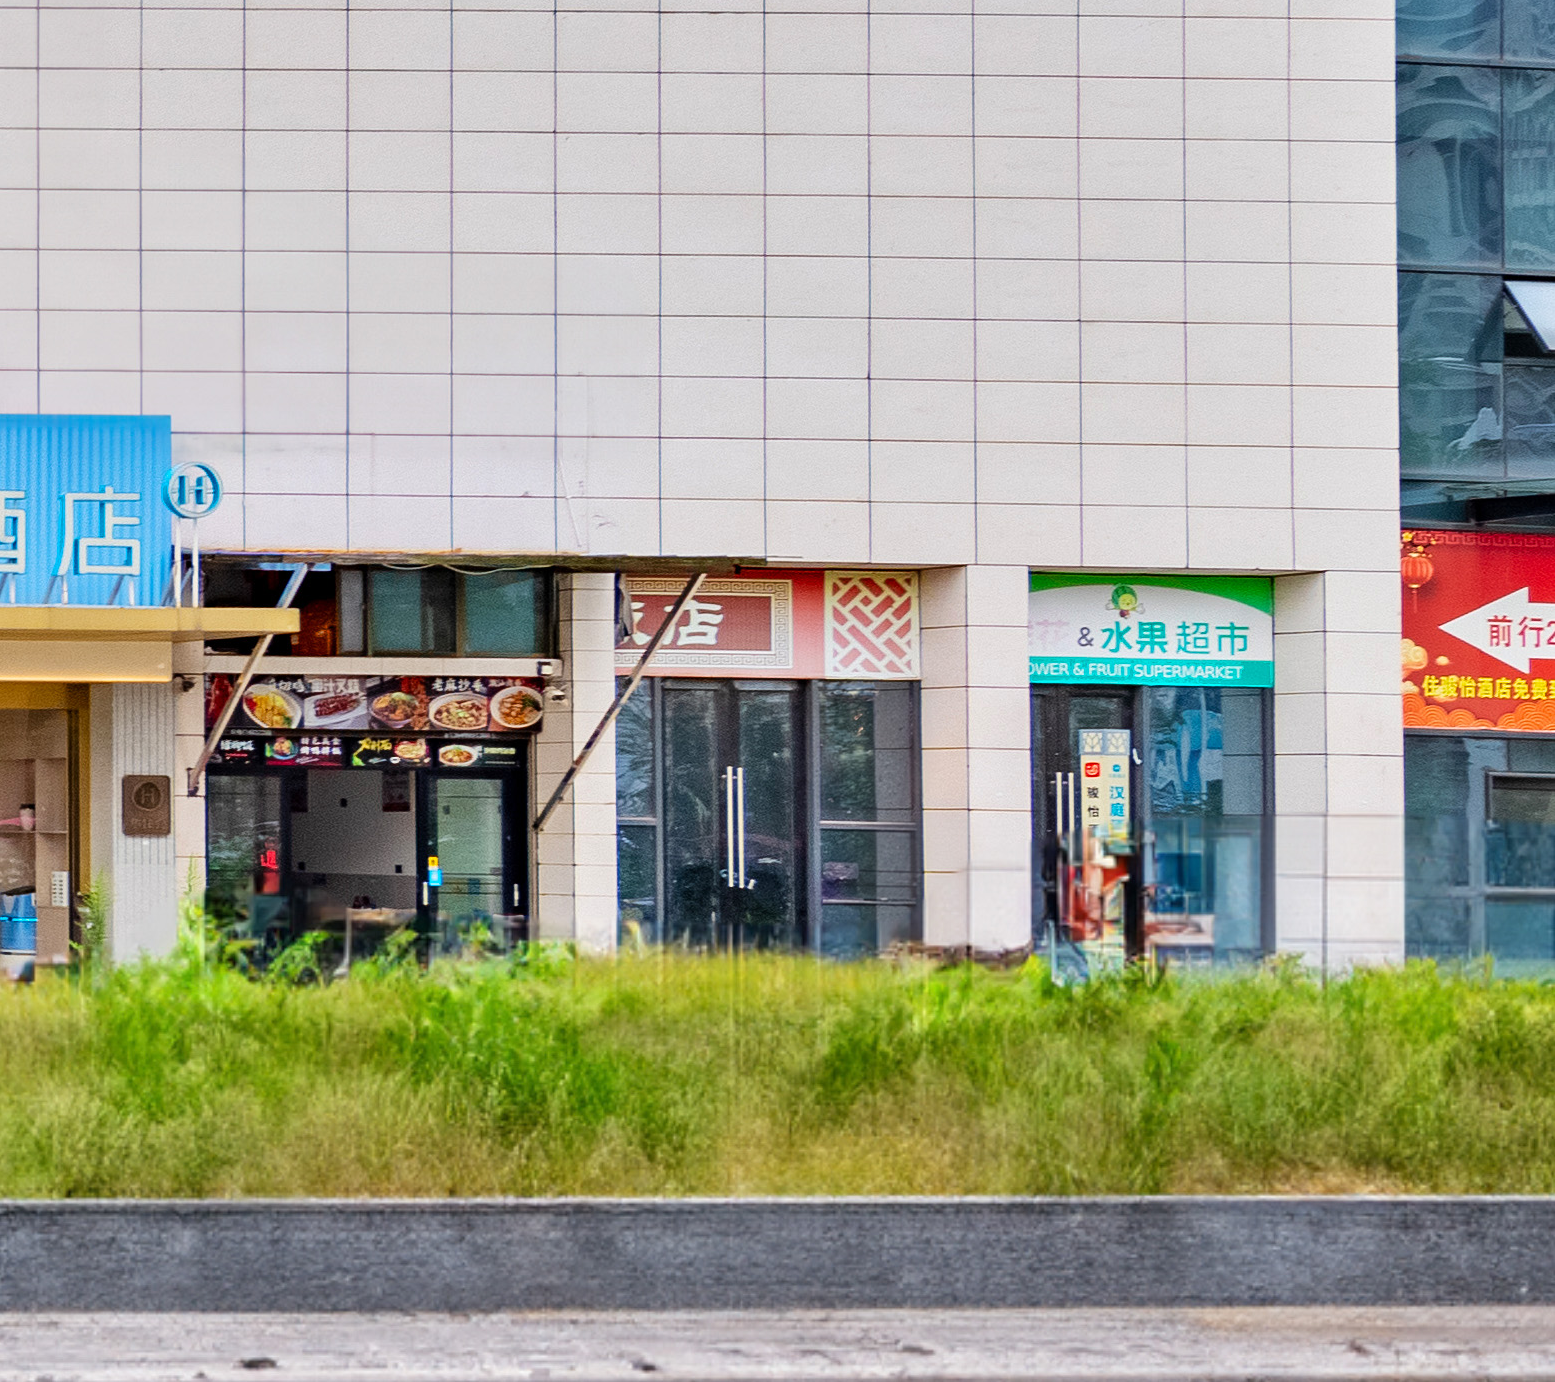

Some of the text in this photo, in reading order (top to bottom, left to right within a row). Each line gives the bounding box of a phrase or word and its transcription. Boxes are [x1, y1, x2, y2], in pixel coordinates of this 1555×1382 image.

[1101, 620, 1250, 656] 水果超市
[1072, 663, 1086, 677] &
[1089, 663, 1131, 678] FRUIT
[1134, 663, 1244, 680] SUPERMARKET
